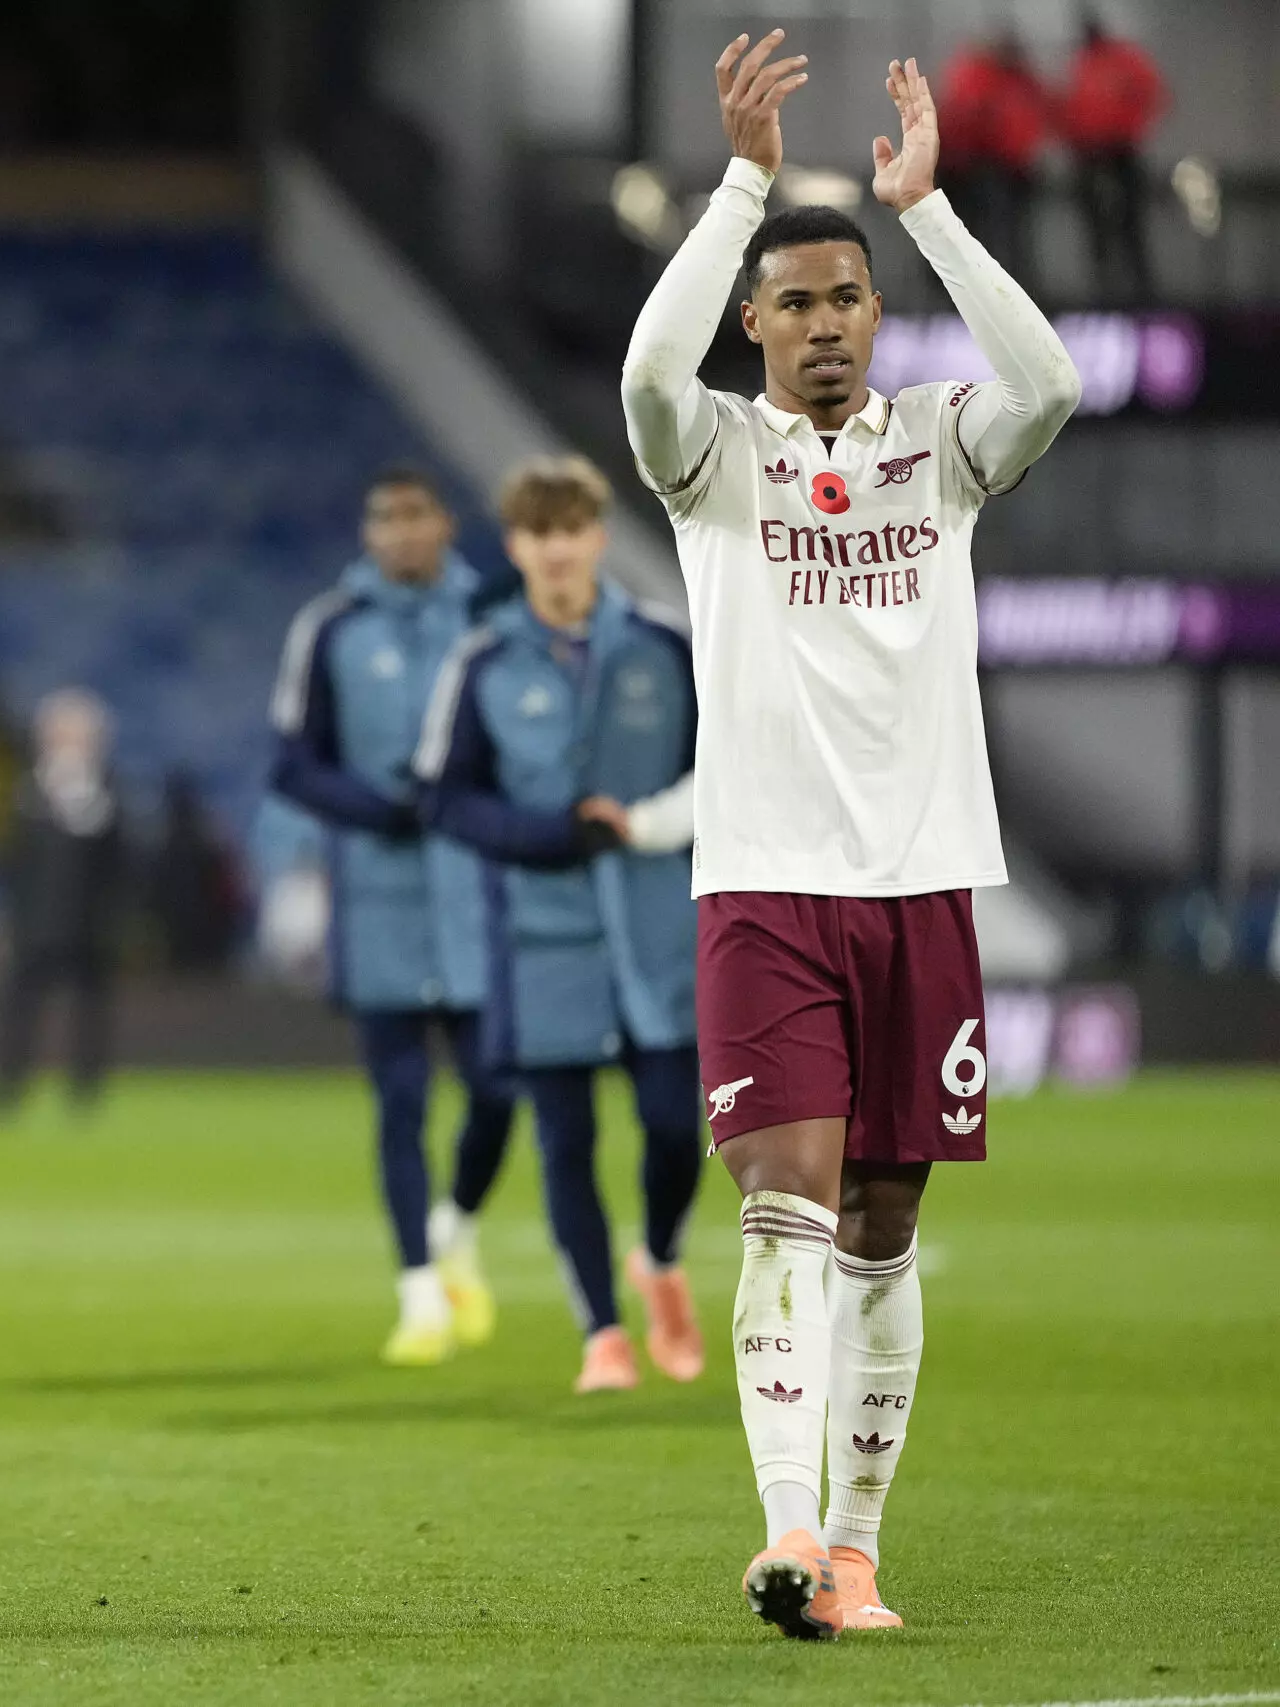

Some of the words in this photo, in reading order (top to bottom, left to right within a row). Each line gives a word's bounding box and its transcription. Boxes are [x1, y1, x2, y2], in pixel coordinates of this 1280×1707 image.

[760, 516, 940, 568] Emirates
[788, 569, 829, 606] FLY
[836, 567, 921, 609] BETTER
[941, 1018, 987, 1098] 6
[744, 1336, 792, 1354] AFC
[861, 1393, 907, 1409] AFC
